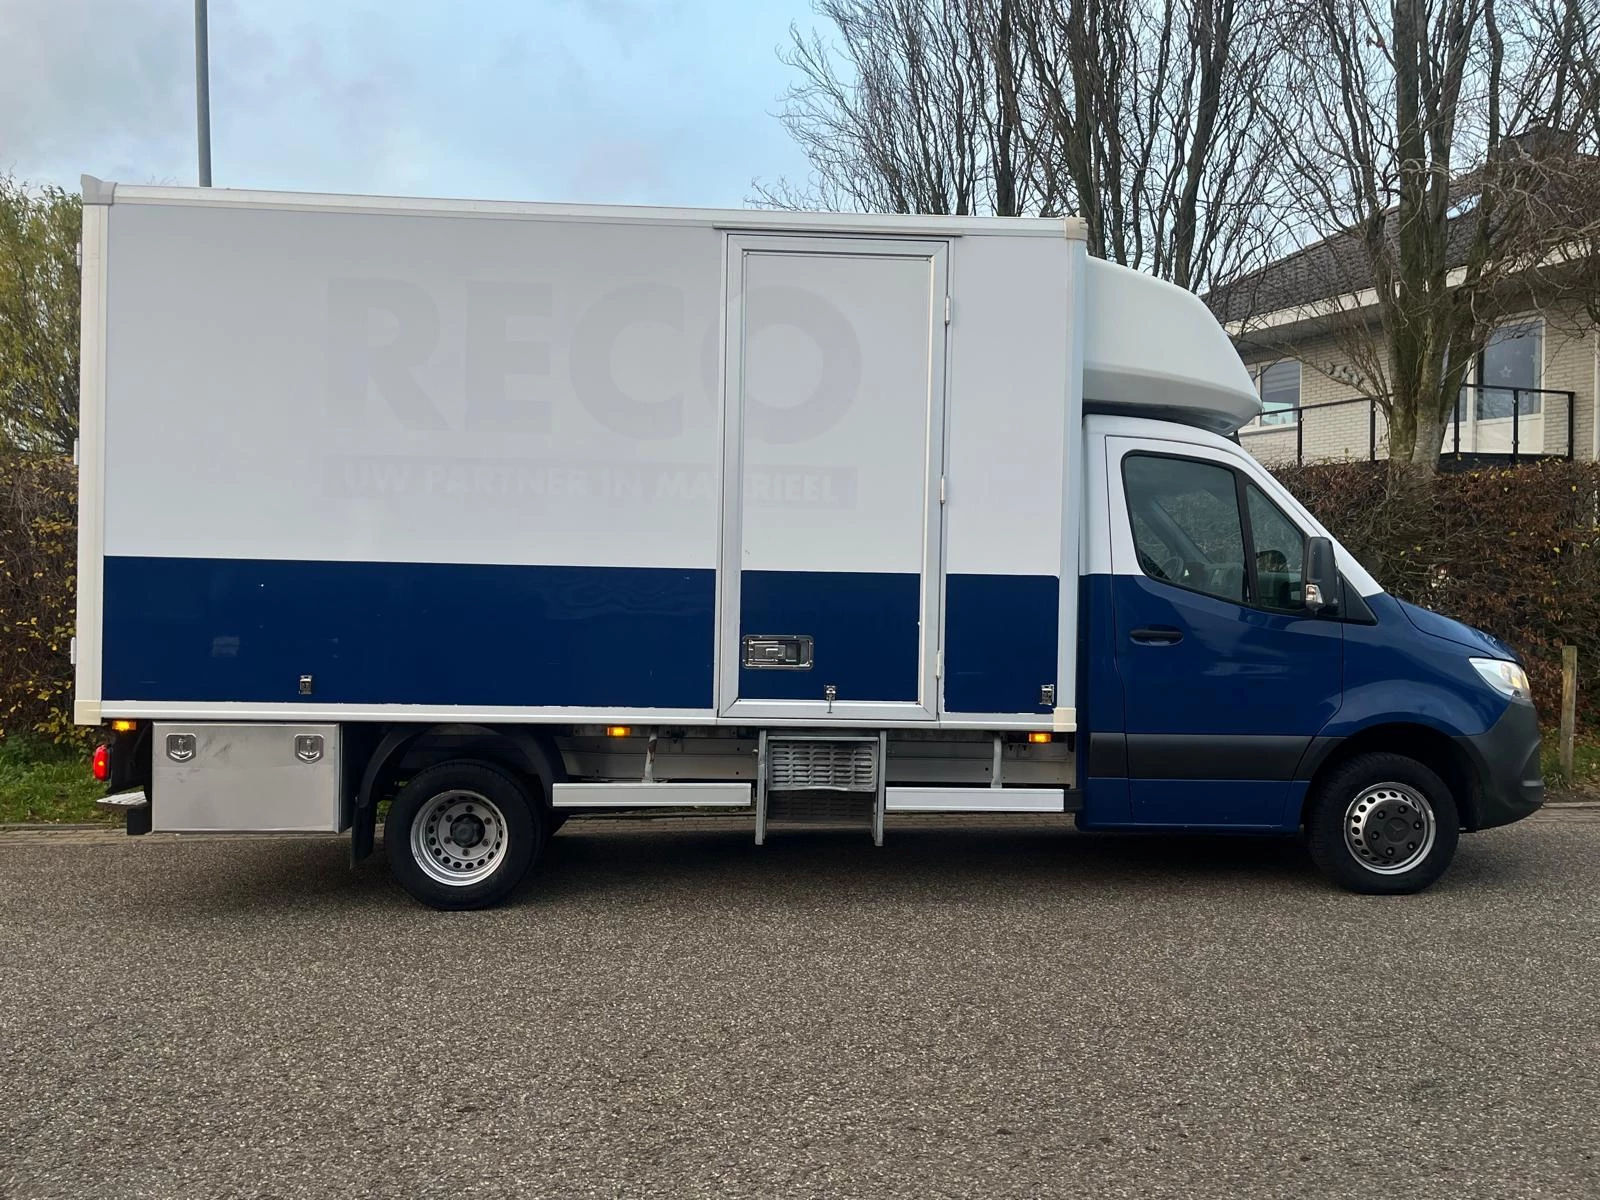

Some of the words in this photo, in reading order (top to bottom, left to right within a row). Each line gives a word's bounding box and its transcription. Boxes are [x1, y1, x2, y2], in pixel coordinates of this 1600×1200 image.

[326, 277, 862, 445] RECO
[422, 467, 592, 496] PARTNER
[604, 468, 643, 498] IN
[656, 471, 839, 503] MARIEEL
